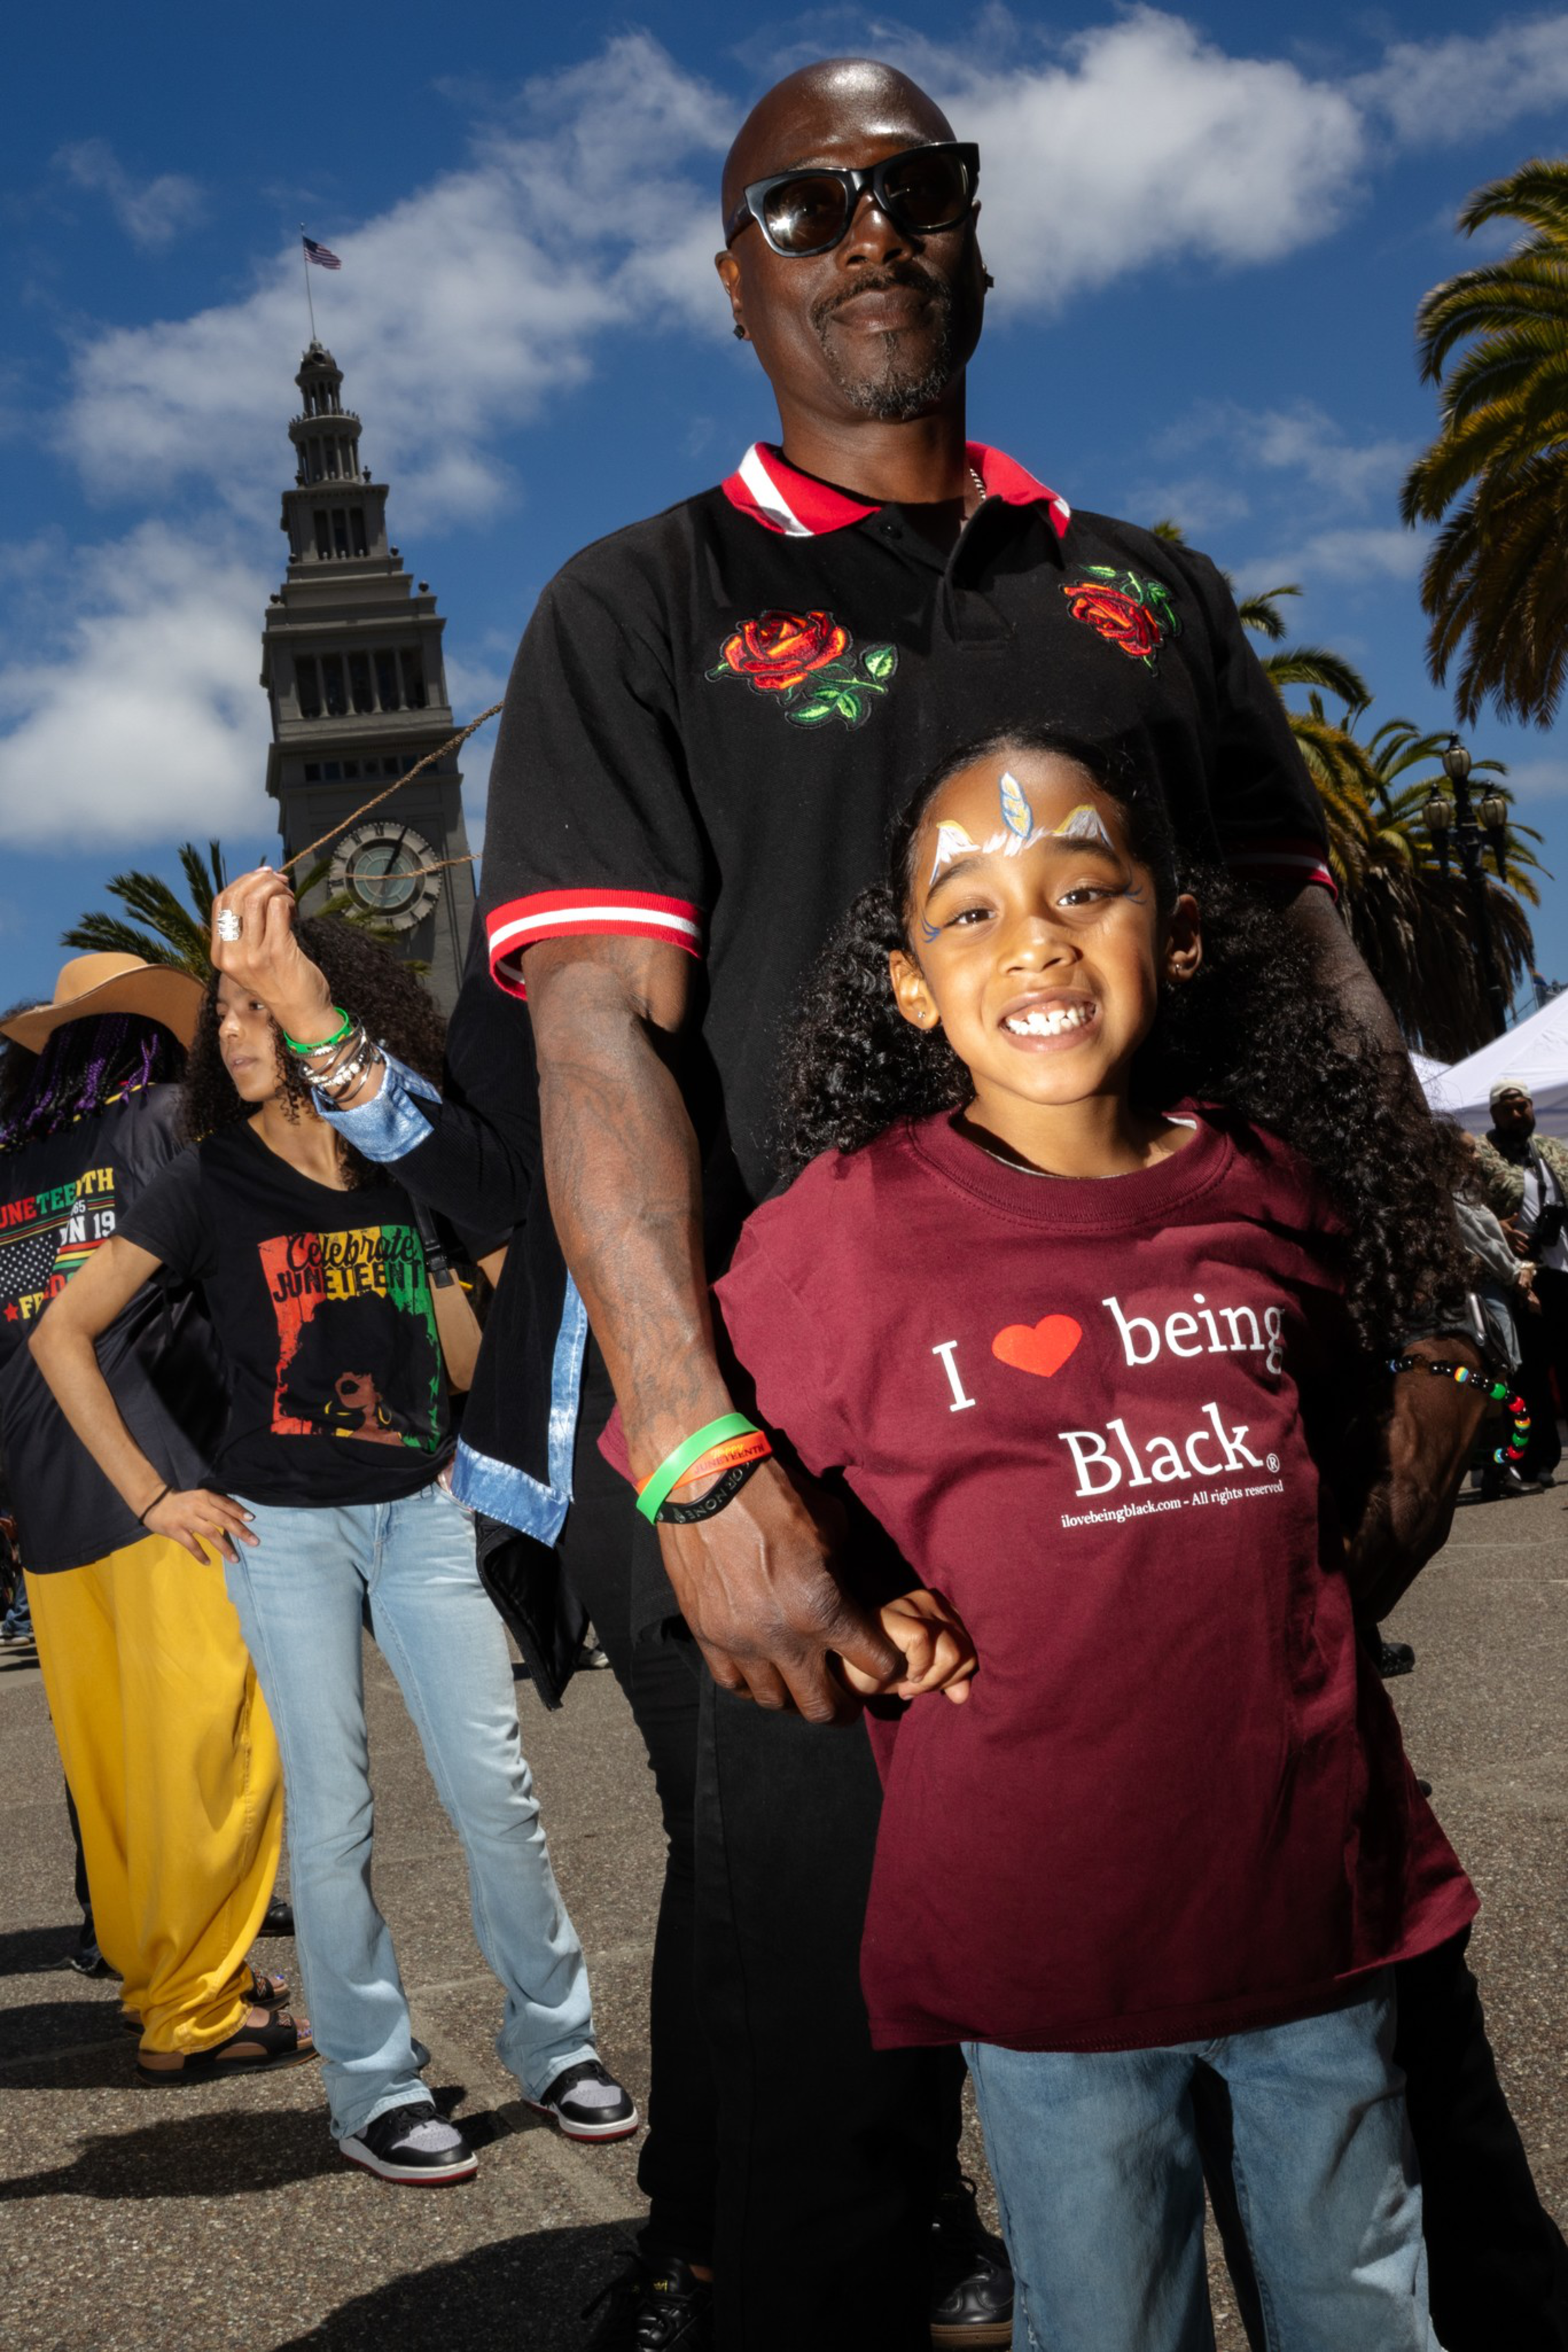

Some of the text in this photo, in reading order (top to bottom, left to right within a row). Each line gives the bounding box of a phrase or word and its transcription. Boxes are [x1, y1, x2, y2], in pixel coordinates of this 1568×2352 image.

[94, 1211, 116, 1239] 19
[287, 1227, 418, 1271] Celebrate
[932, 1293, 1285, 1412] I being
[695, 1444, 765, 1474] JUNETEENTH
[685, 1488, 727, 1519] NONE
[1061, 1499, 1181, 1528] ilovebeingblack.com
[1192, 1491, 1209, 1506] All
[1210, 1487, 1243, 1505] rights
[1245, 1479, 1284, 1497] reserved
